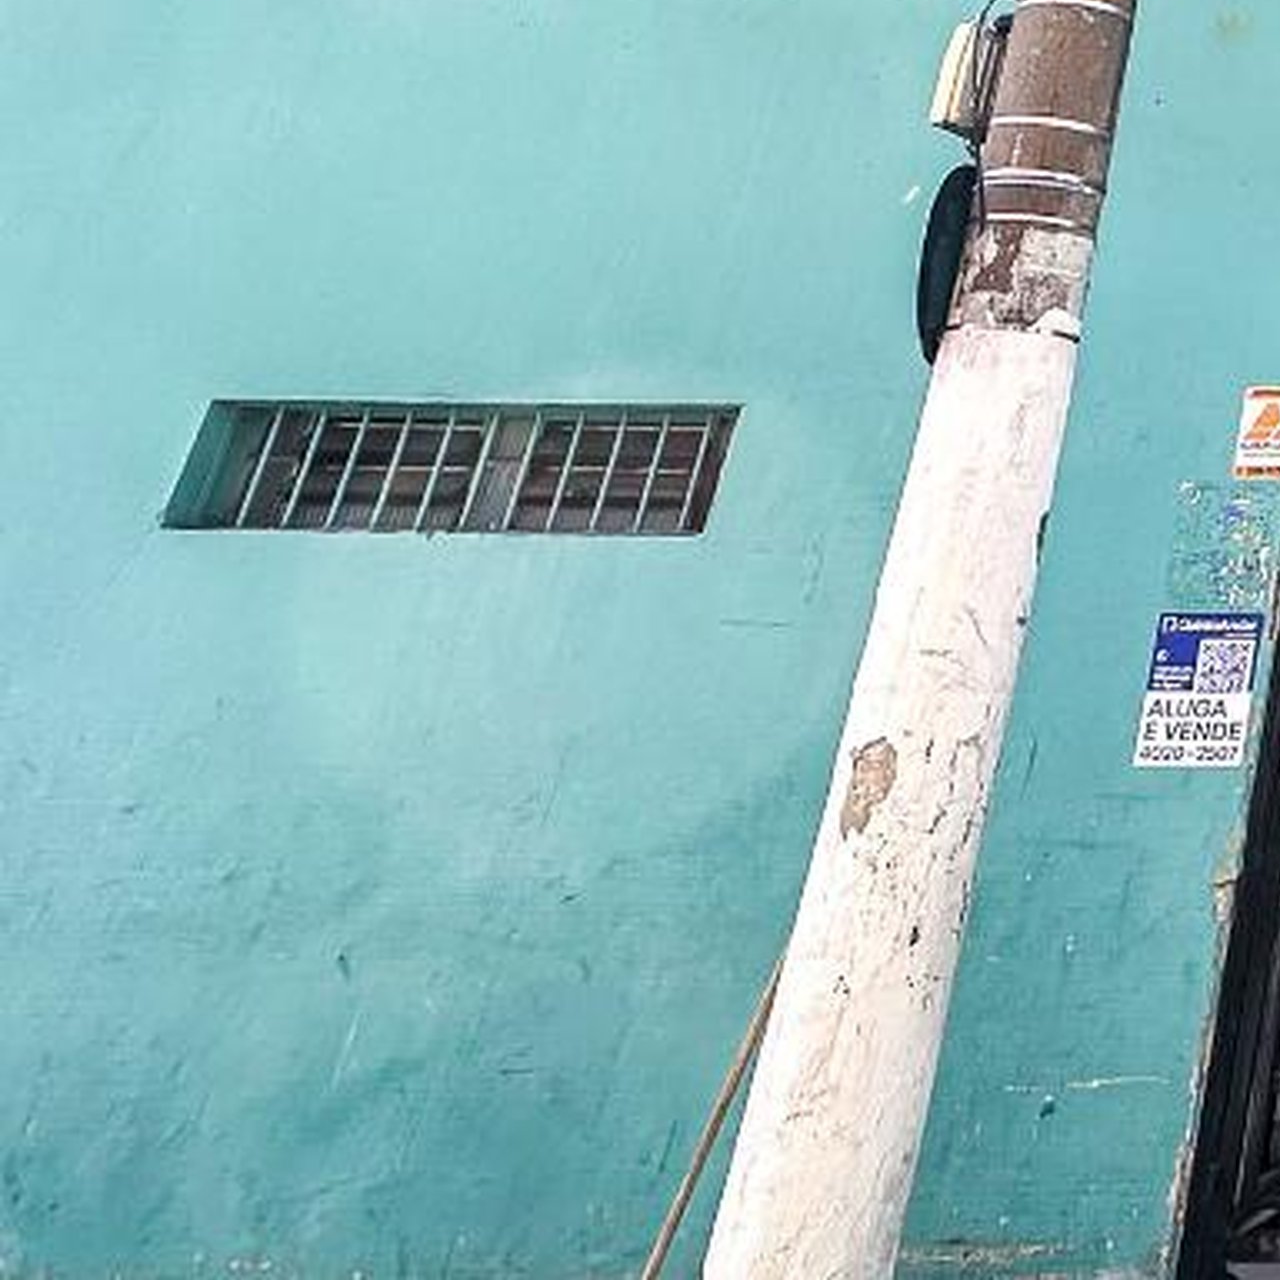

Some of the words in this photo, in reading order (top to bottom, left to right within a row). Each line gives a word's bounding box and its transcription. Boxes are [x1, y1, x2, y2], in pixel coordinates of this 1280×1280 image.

[1147, 698, 1227, 718] ALUGA
[1143, 722, 1157, 741] E
[1165, 722, 1243, 741] VENDE
